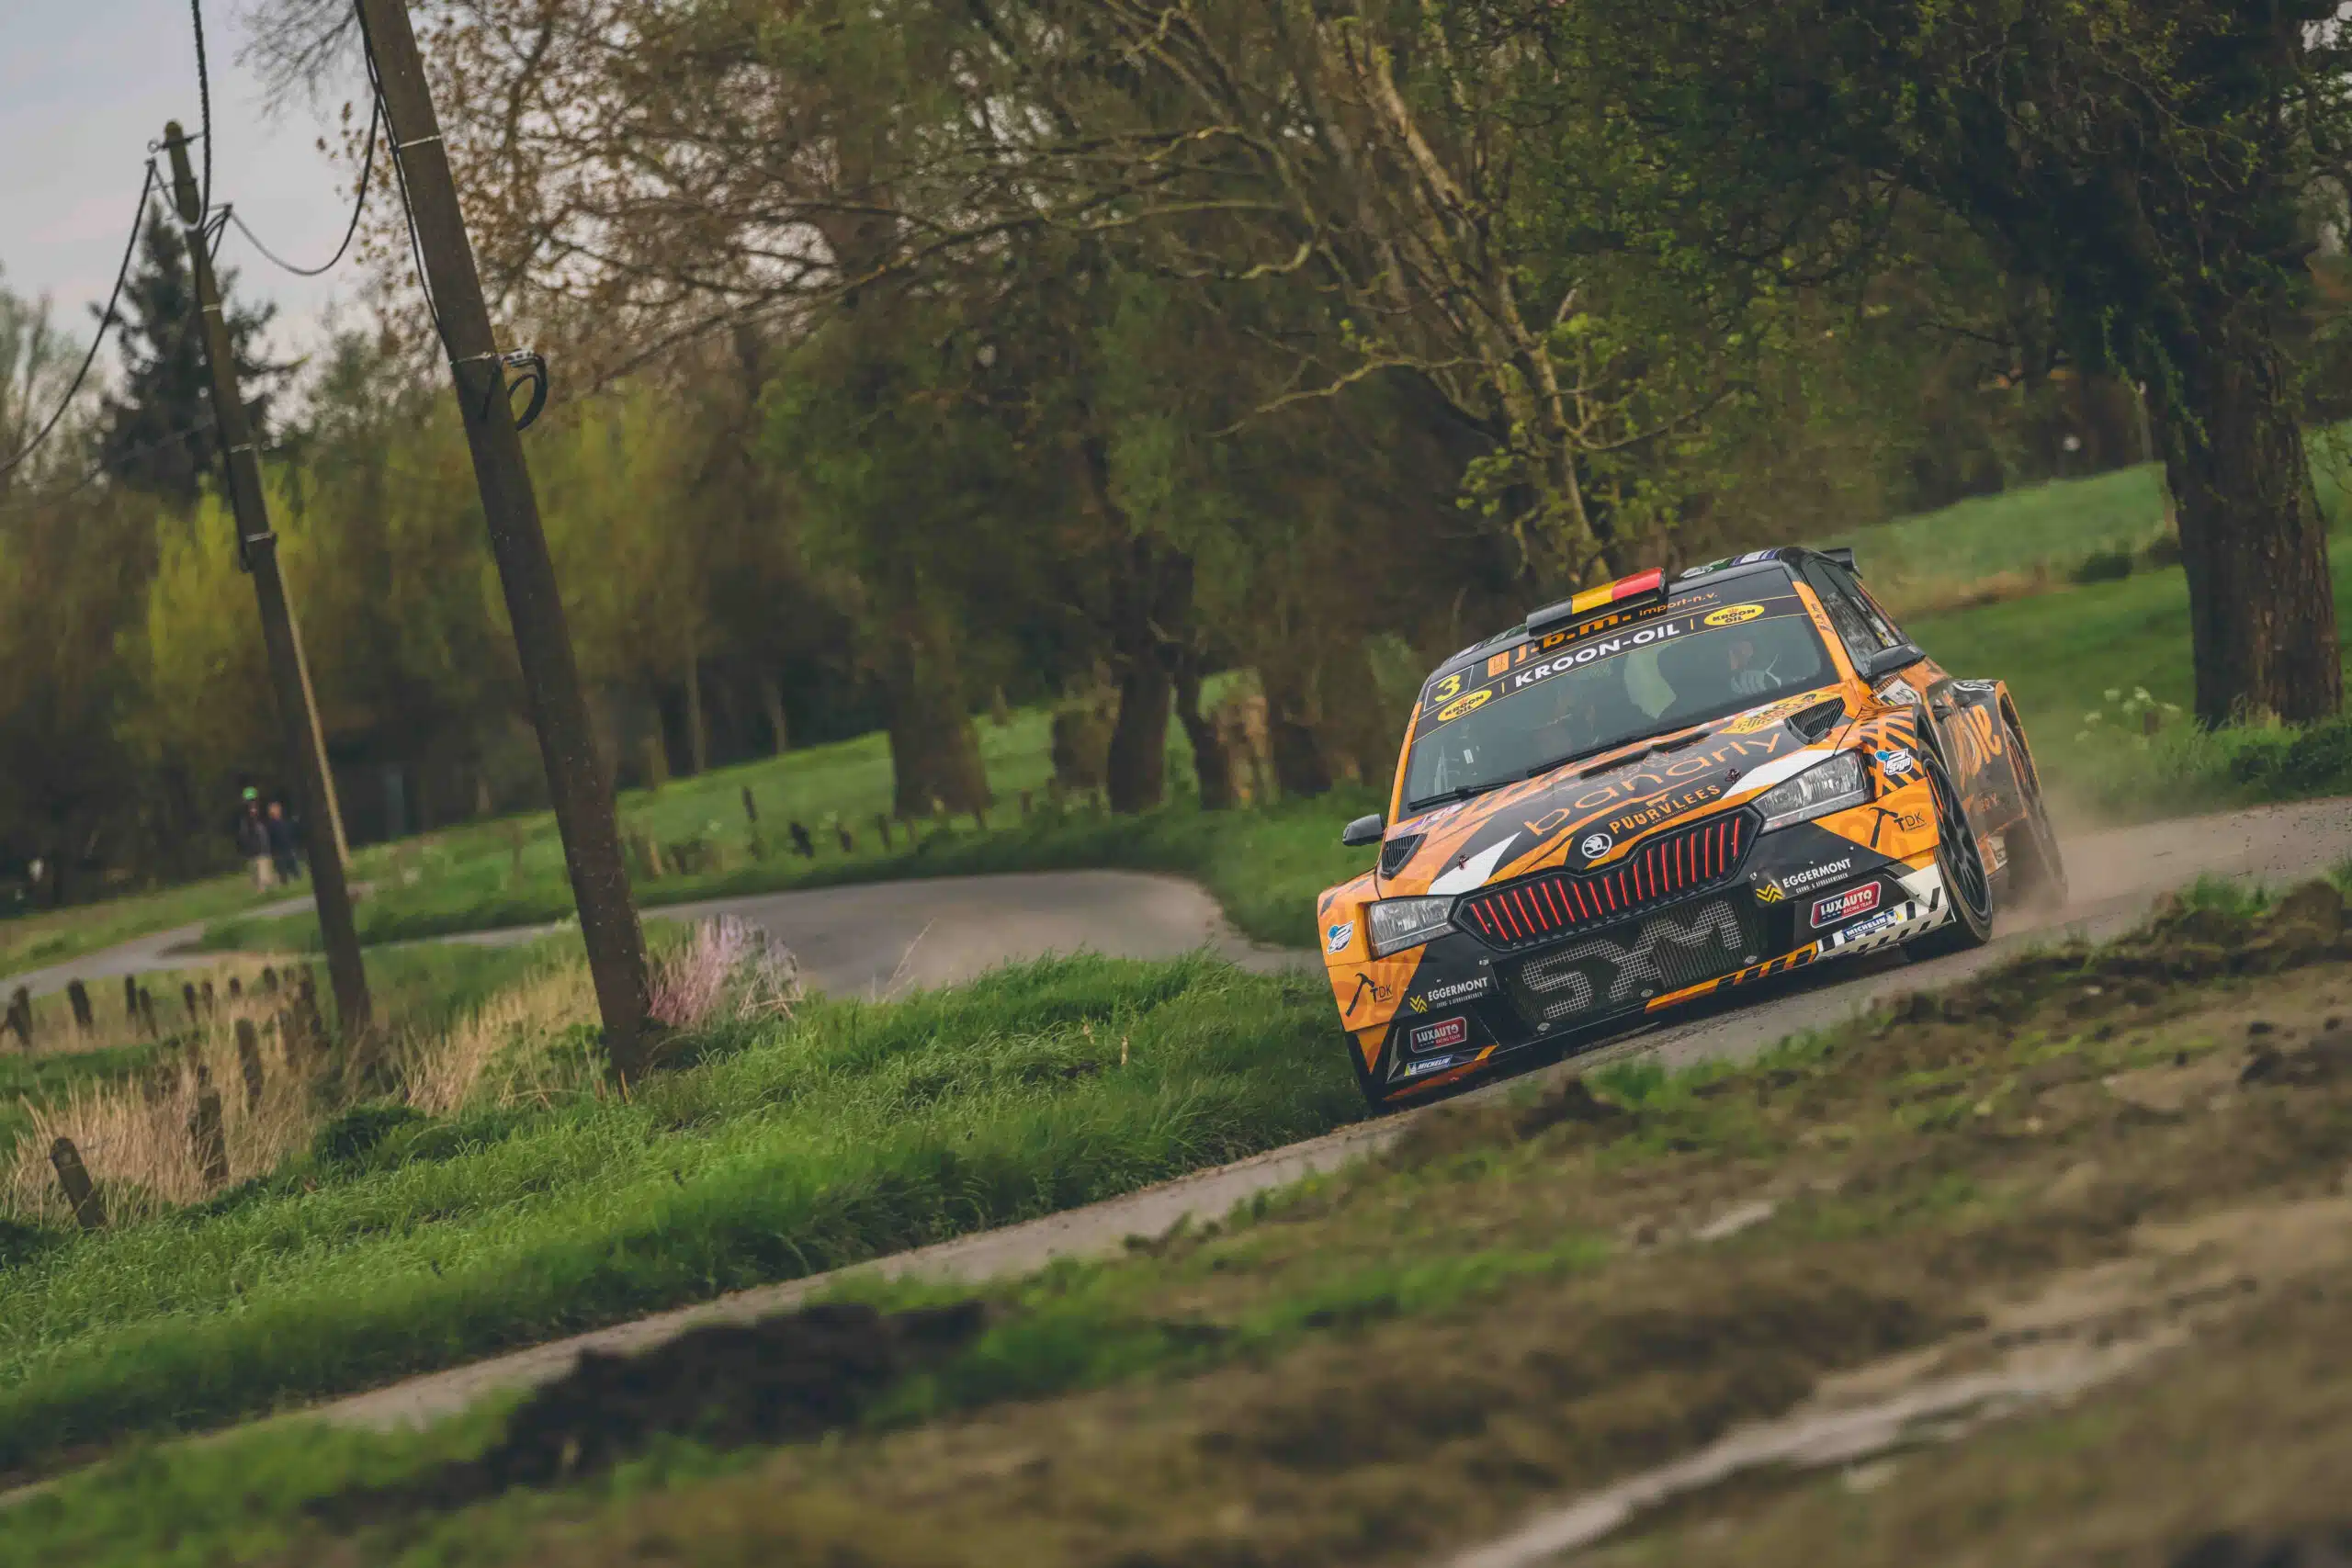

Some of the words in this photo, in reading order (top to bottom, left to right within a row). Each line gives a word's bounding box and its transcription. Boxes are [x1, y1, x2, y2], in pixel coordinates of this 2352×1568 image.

[1712, 607, 1757, 623] KROON
[1724, 615, 1744, 625] OIL
[1515, 623, 1680, 688] KROON-OIL
[1434, 674, 1462, 703] 3
[1444, 694, 1485, 717] KROON
[1522, 732, 1781, 837] banarly
[1608, 784, 1722, 834] PUURVLEES
[1894, 809, 1925, 832] TDK
[1781, 857, 1852, 889] EGGERMONT
[1820, 889, 1873, 917] LUXAUTO
[1845, 918, 1886, 937] MICHELIN
[1370, 985, 1393, 1004] TDK
[1427, 976, 1488, 1002] EGGERMONT
[1416, 1023, 1460, 1043] LUXAUTO
[1417, 1057, 1451, 1070] MICHELIN
